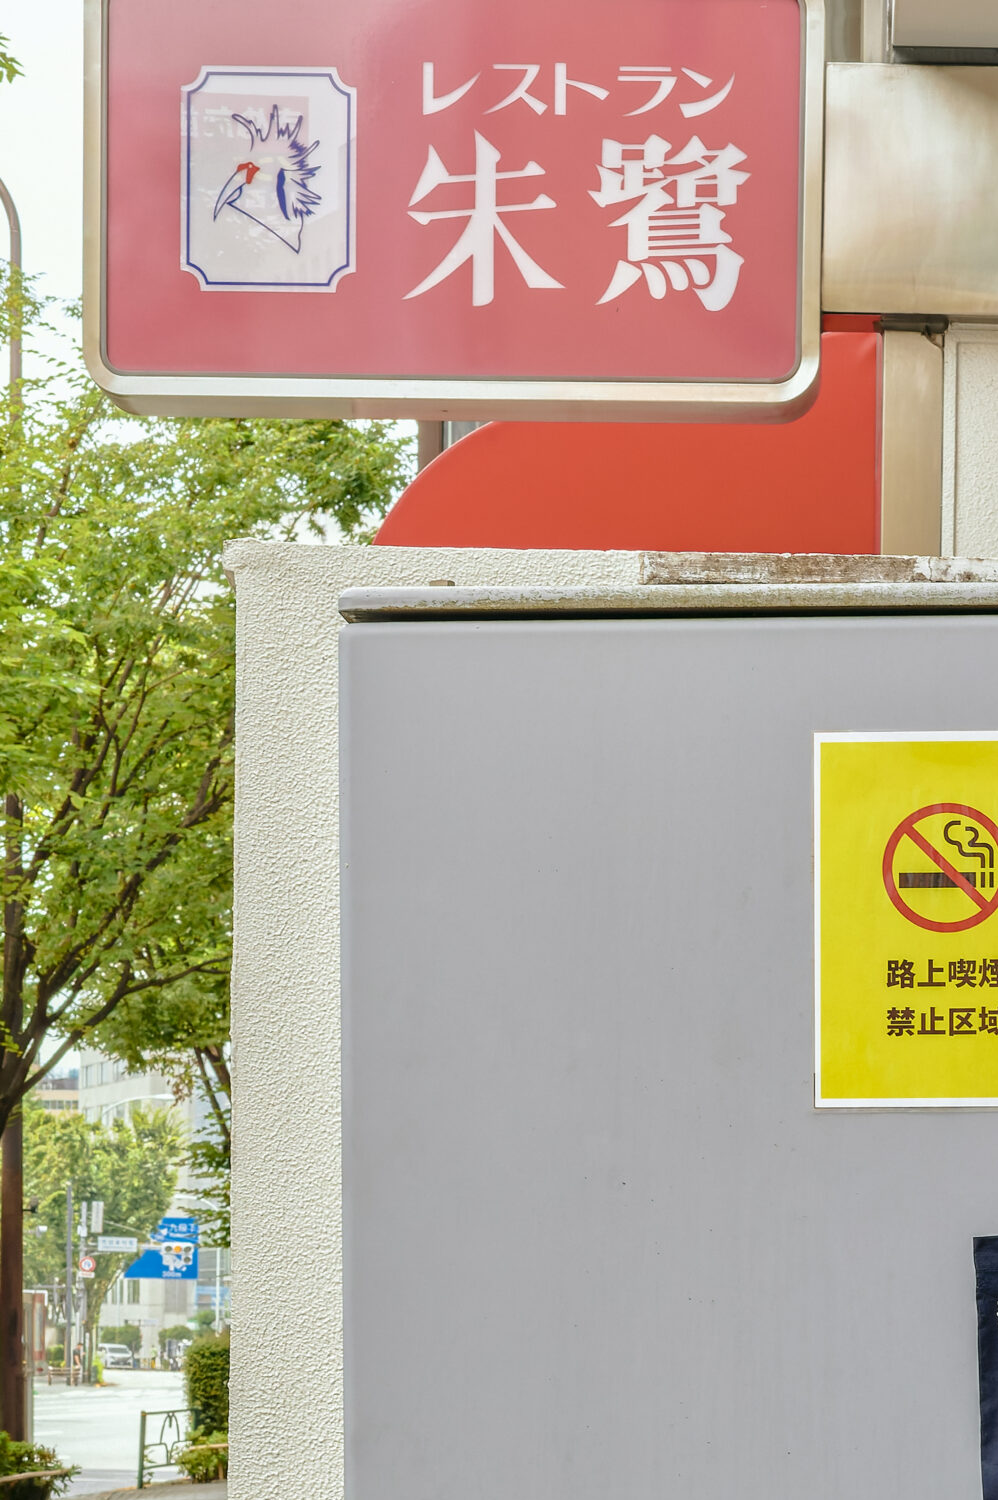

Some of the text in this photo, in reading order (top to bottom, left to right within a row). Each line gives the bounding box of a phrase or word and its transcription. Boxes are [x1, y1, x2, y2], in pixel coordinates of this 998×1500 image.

[422, 61, 735, 119] レストラン
[402, 129, 752, 312] 朱鷺
